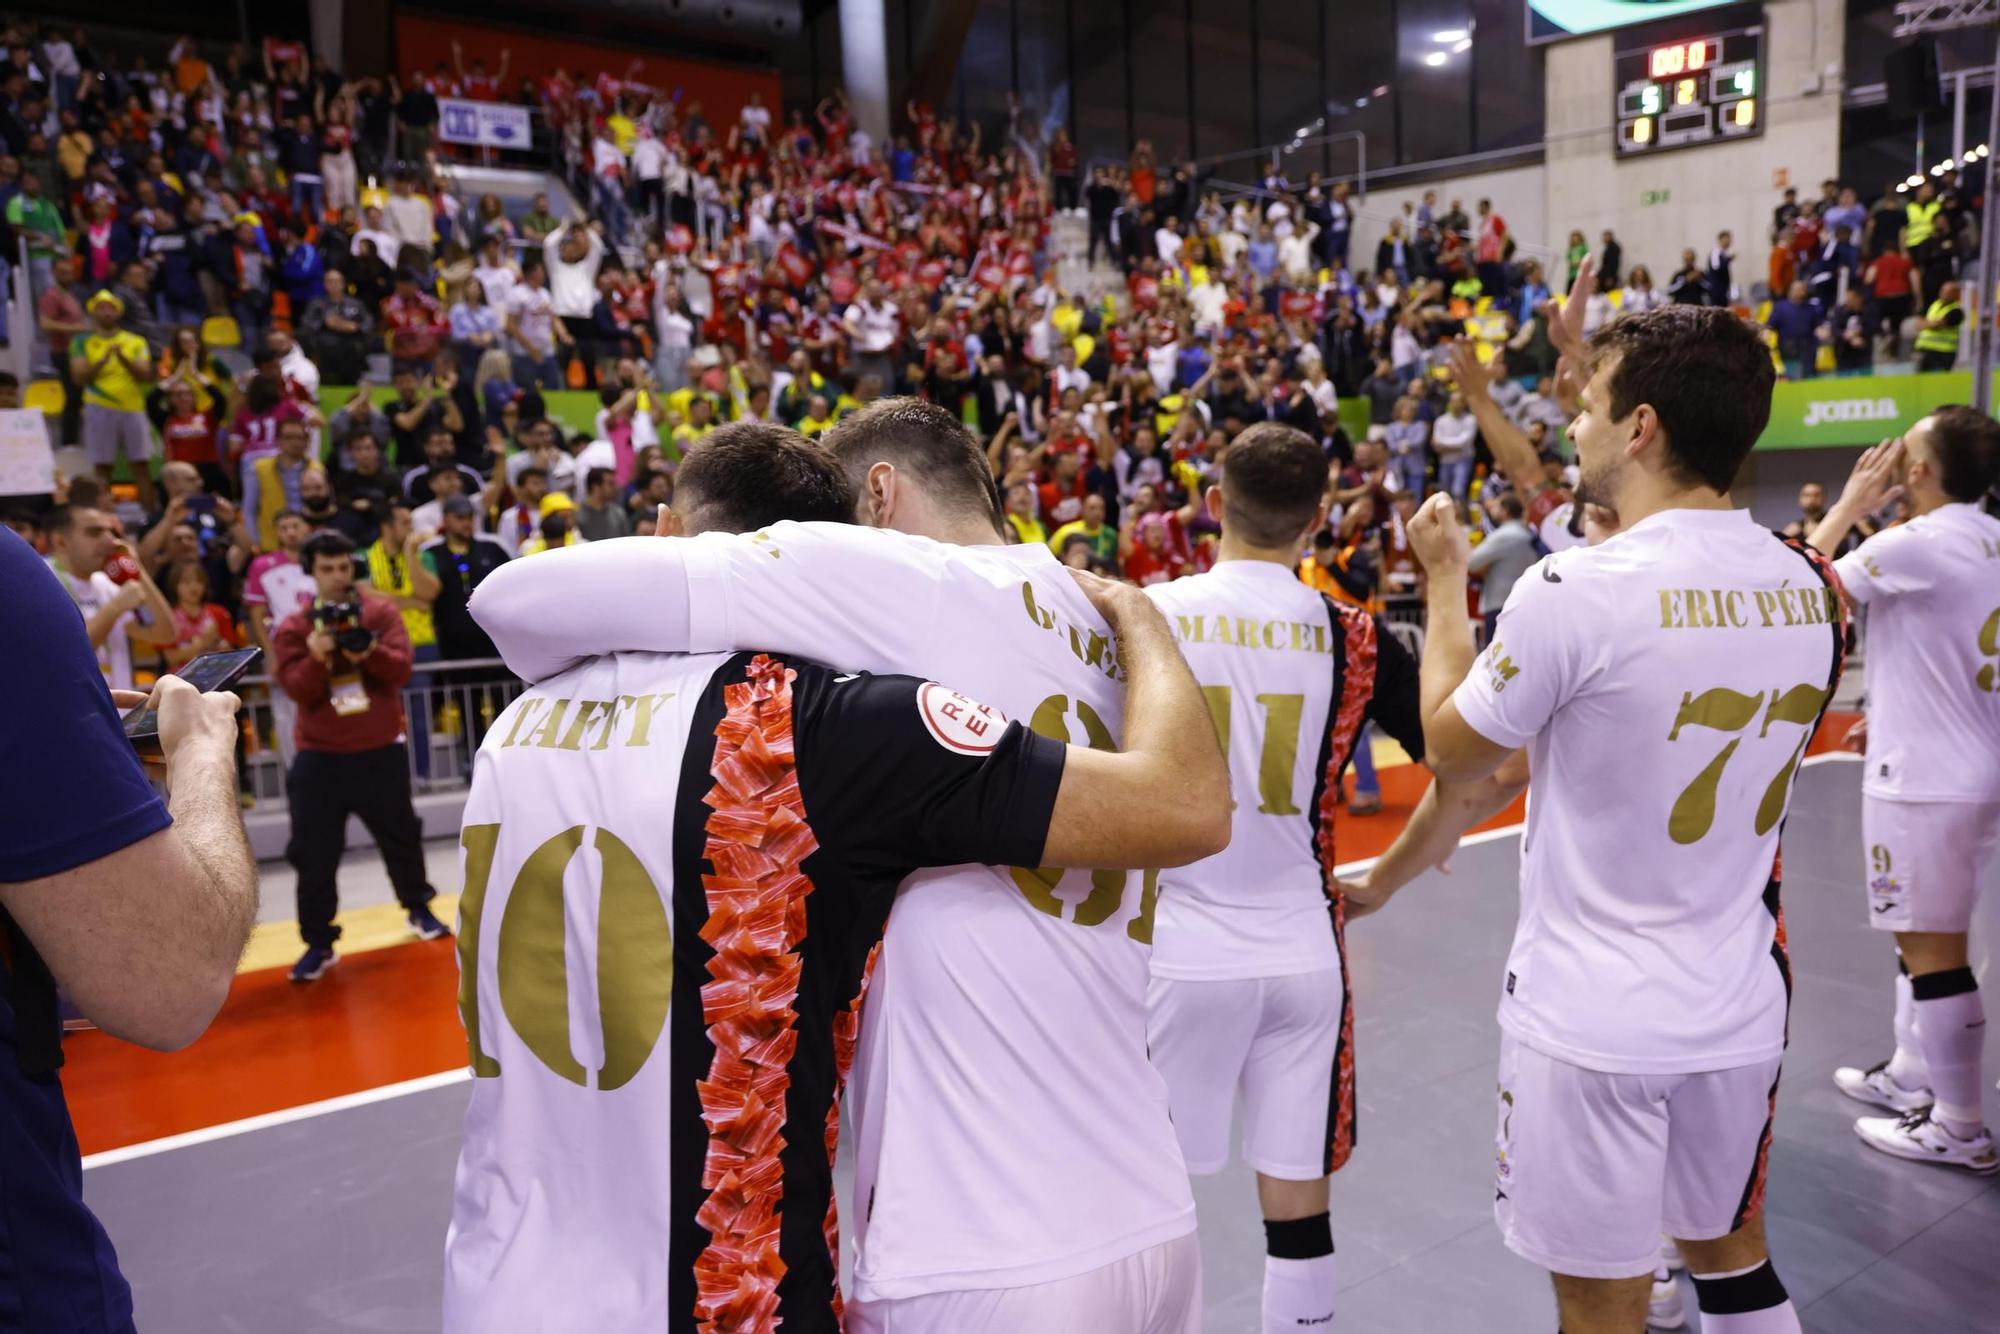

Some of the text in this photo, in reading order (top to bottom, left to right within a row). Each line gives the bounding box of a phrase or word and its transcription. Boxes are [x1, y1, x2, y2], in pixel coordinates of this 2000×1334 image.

[1641, 86, 1660, 115] 5
[1677, 79, 1695, 105] 2
[1657, 588, 1749, 629] ERIC
[501, 692, 676, 751] TAFFY
[1667, 683, 1832, 846] 77
[1872, 845, 1891, 873] 9
[456, 822, 674, 1091] 10
